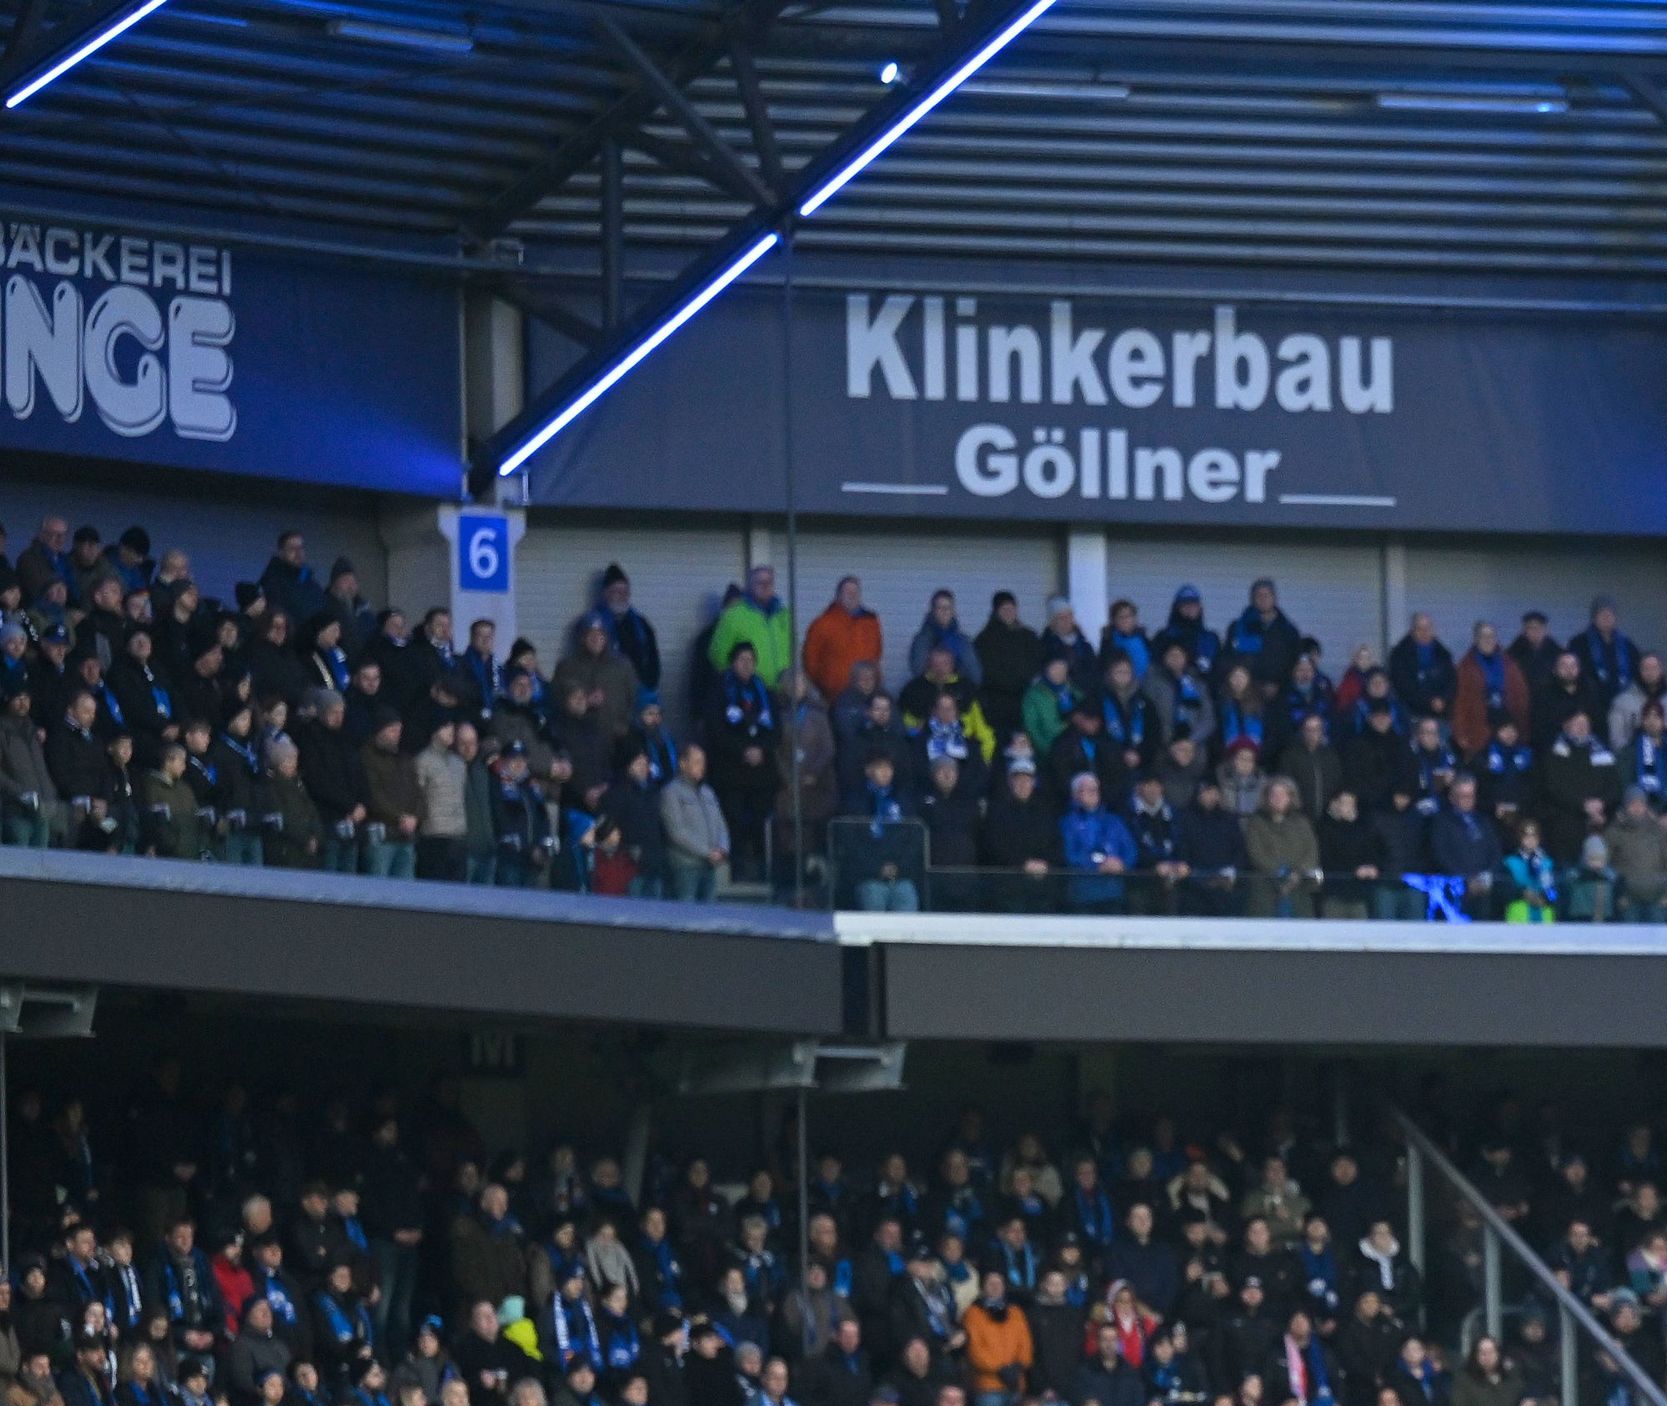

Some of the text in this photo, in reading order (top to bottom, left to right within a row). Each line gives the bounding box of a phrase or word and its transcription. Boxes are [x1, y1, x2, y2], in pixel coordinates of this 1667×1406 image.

[0, 222, 232, 297] ÄCKEREI
[0, 274, 238, 442] NGE
[846, 294, 1394, 414] Klinkerbau
[955, 422, 1282, 503] Göllner
[469, 526, 499, 579] 6
